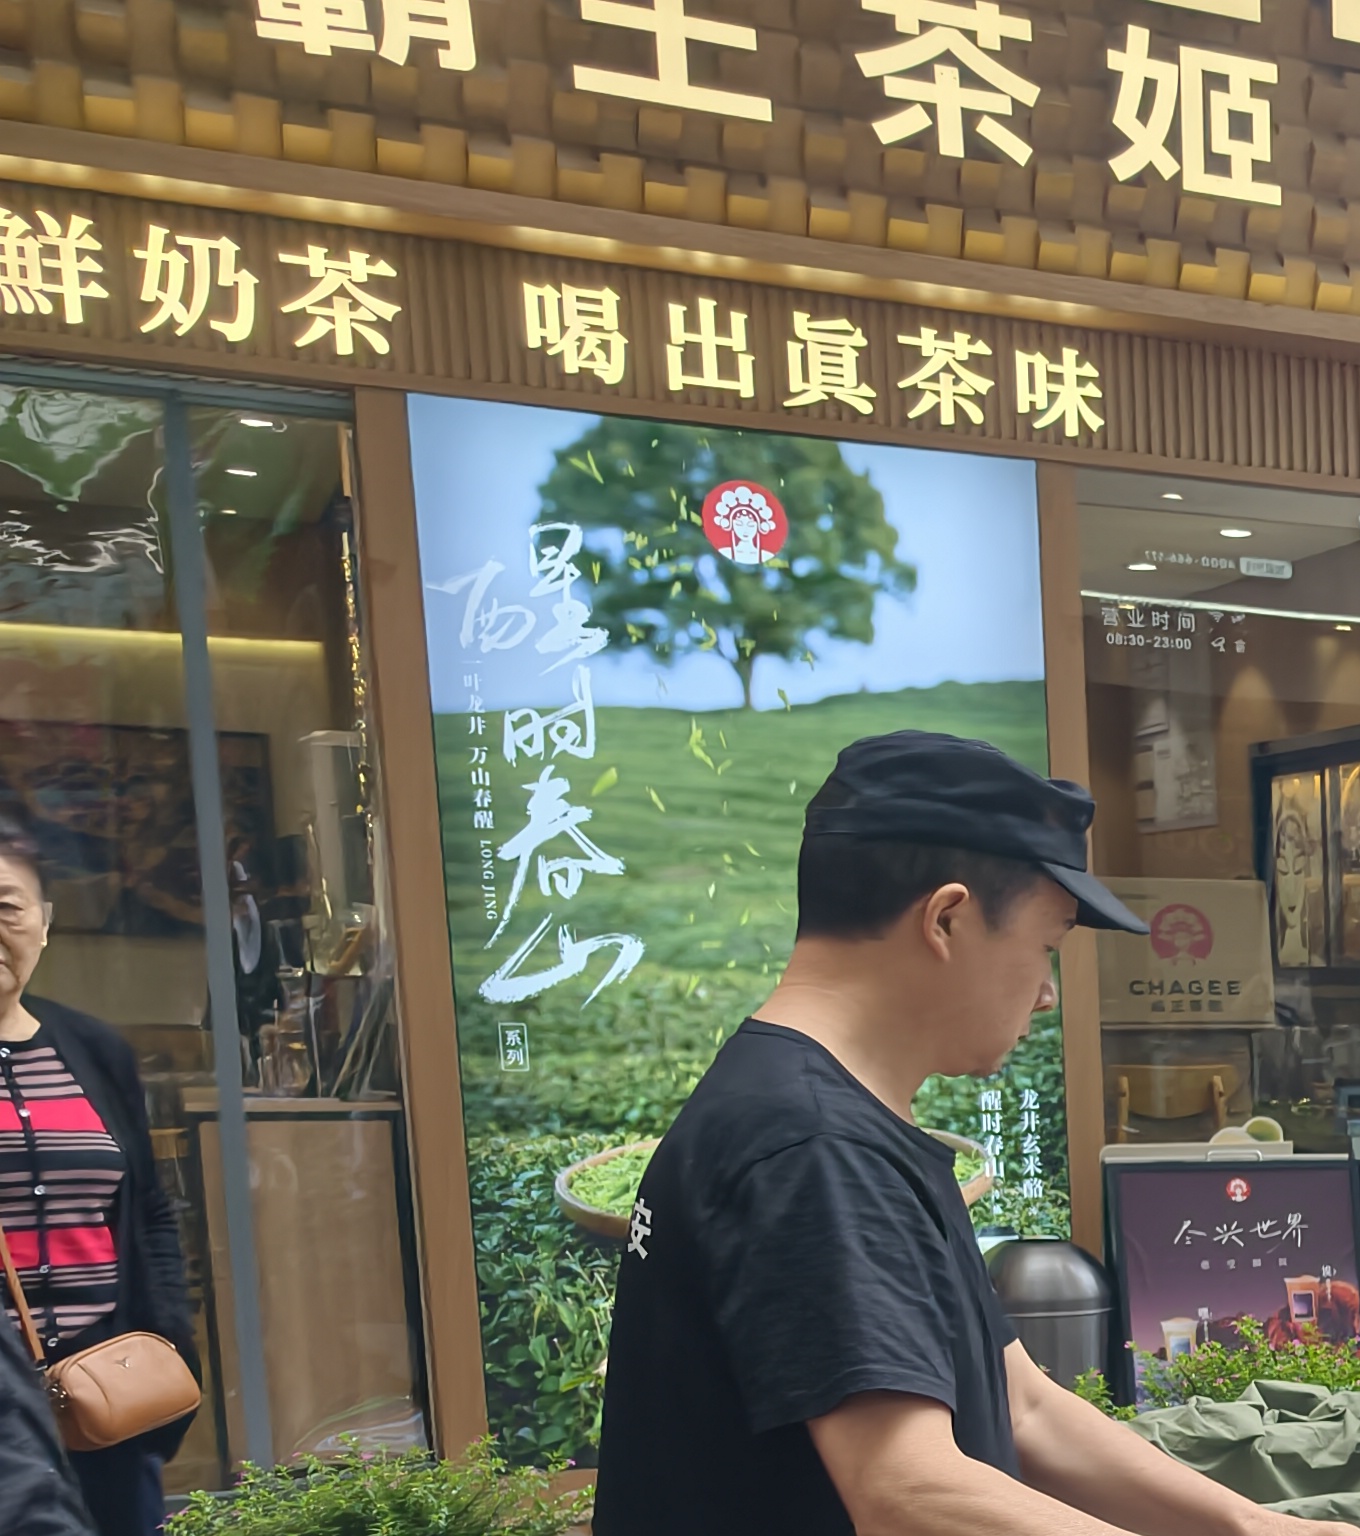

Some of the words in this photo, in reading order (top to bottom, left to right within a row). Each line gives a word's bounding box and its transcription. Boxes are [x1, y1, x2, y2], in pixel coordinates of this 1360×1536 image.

[1101, 606, 1196, 633] 营业时间
[1106, 631, 1192, 650] 08:30-23:00
[480, 840, 495, 880] LONG
[482, 885, 498, 920] JING
[1129, 980, 1241, 995] CHAGEE
[505, 1029, 524, 1066] 系列
